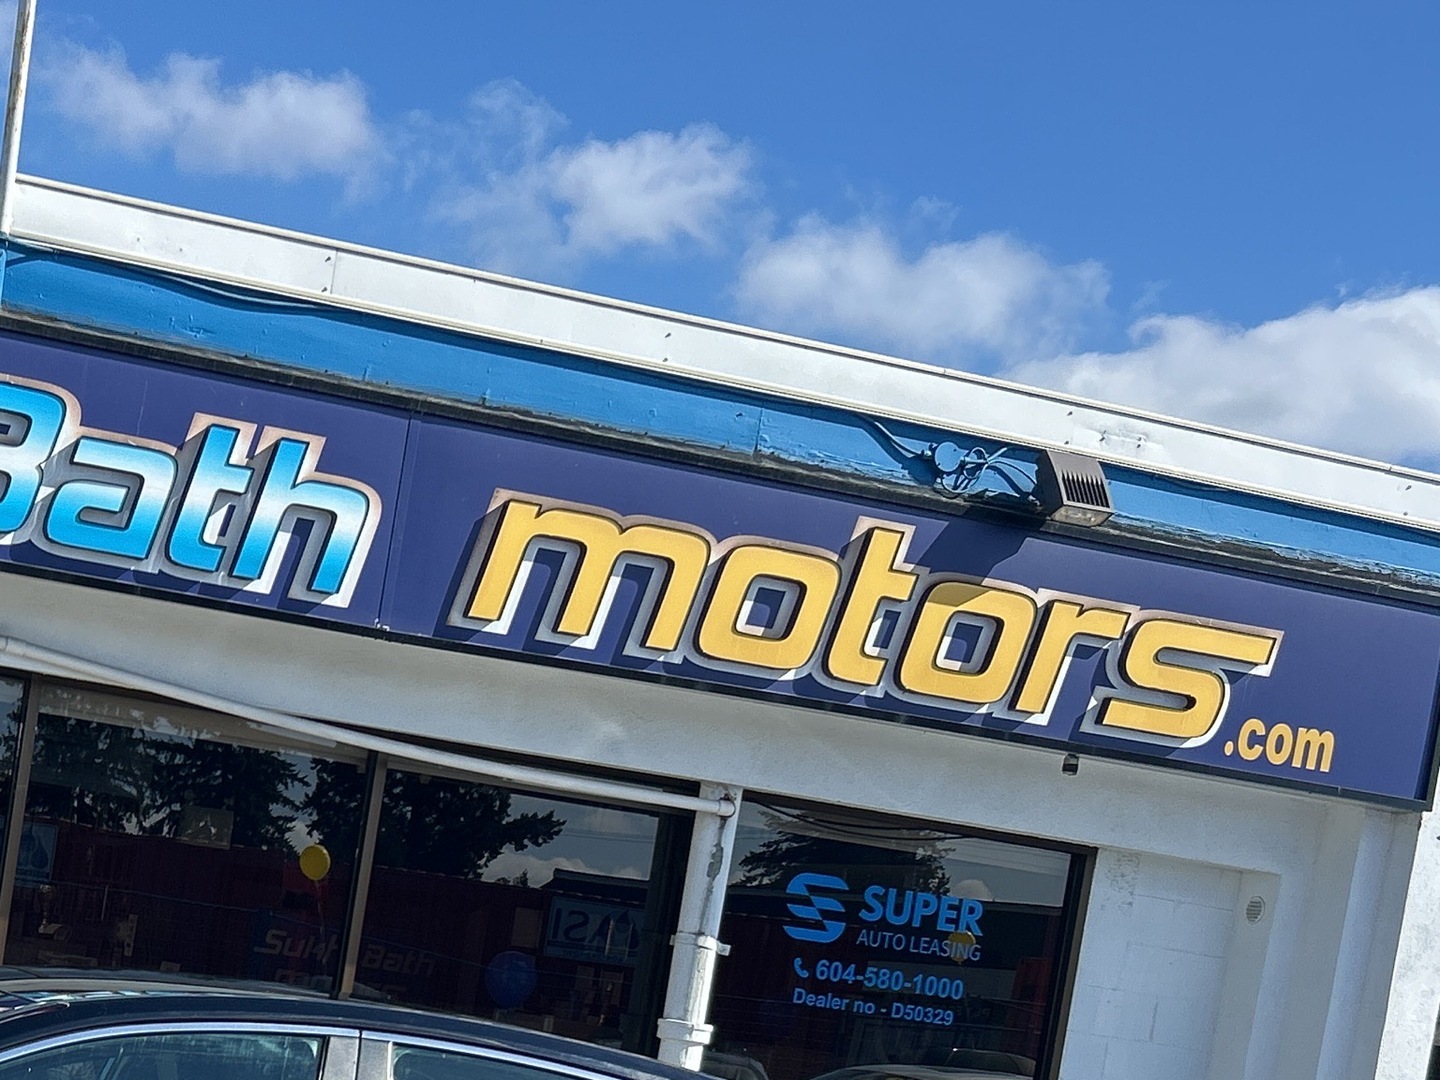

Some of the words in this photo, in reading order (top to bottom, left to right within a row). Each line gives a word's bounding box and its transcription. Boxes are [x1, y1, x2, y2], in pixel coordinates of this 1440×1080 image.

[446, 489, 1284, 748] motors
[1224, 716, 1337, 774] .com
[858, 885, 984, 936] SUPER
[855, 929, 906, 951] AUTO
[910, 937, 981, 962] LEASING
[815, 959, 965, 1001] 604-580-1000
[792, 987, 850, 1011] Dealer
[852, 1000, 876, 1015] no
[890, 1002, 955, 1026] D50329
